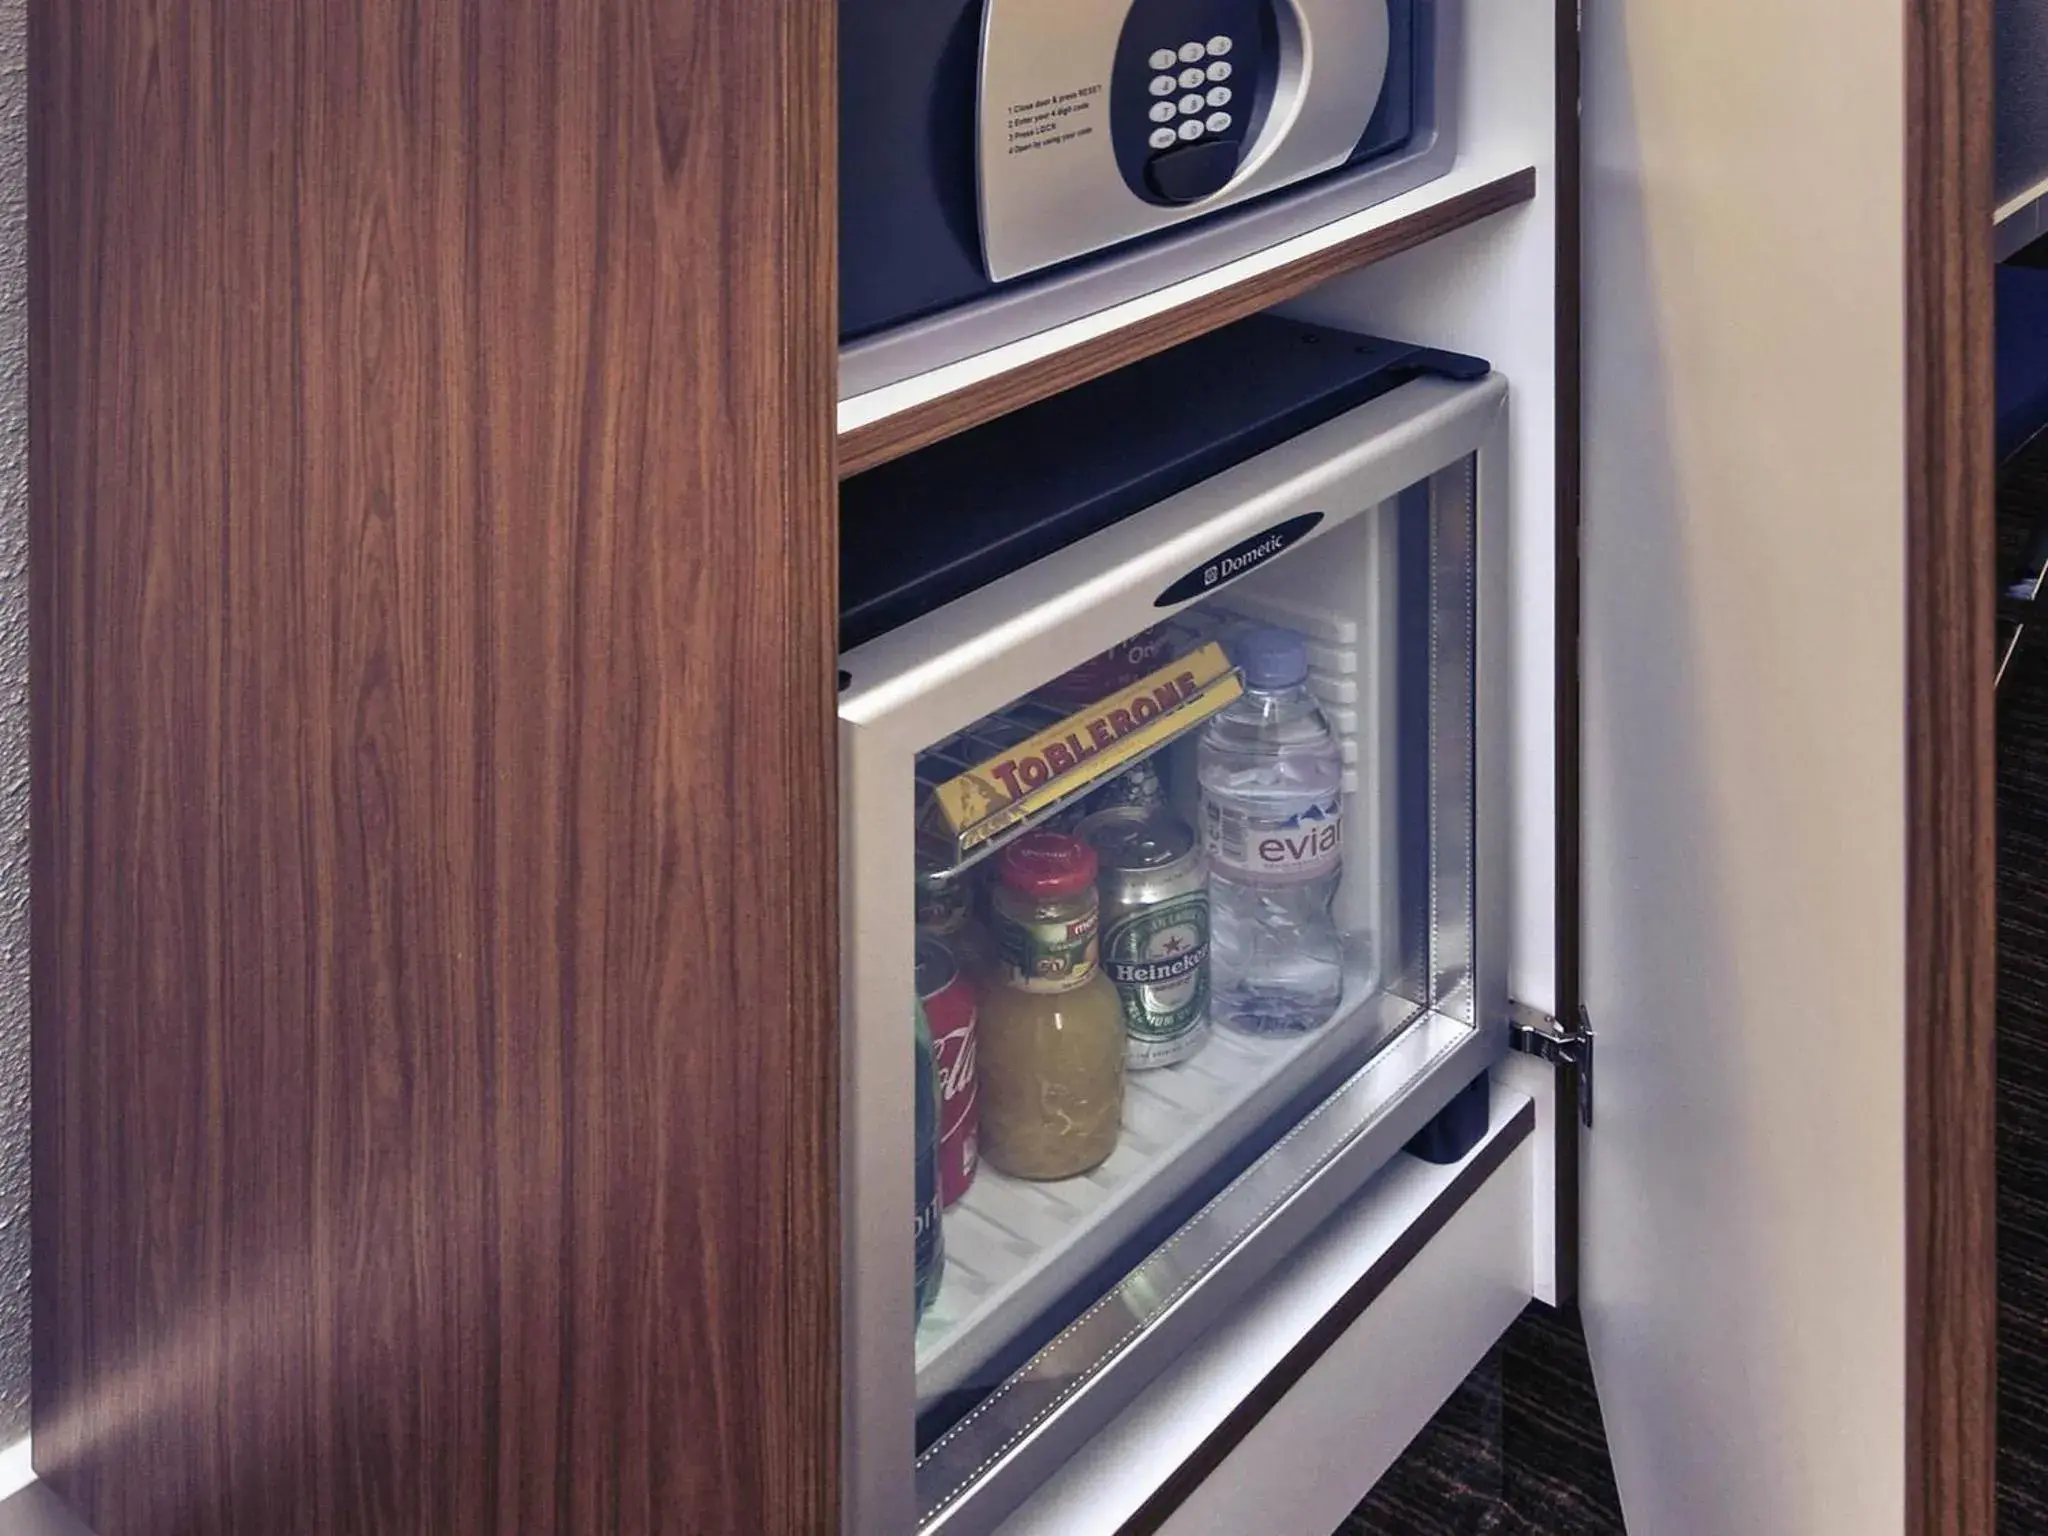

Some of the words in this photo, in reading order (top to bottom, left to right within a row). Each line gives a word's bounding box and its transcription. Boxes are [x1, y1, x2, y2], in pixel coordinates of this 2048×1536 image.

[1035, 98, 1051, 108] door
[1059, 92, 1077, 103] press
[1014, 116, 1033, 127] Enter
[1035, 112, 1050, 122] your
[1014, 130, 1034, 139] Press
[1221, 534, 1283, 577] Dometic
[991, 671, 1200, 801] TOBLERONE
